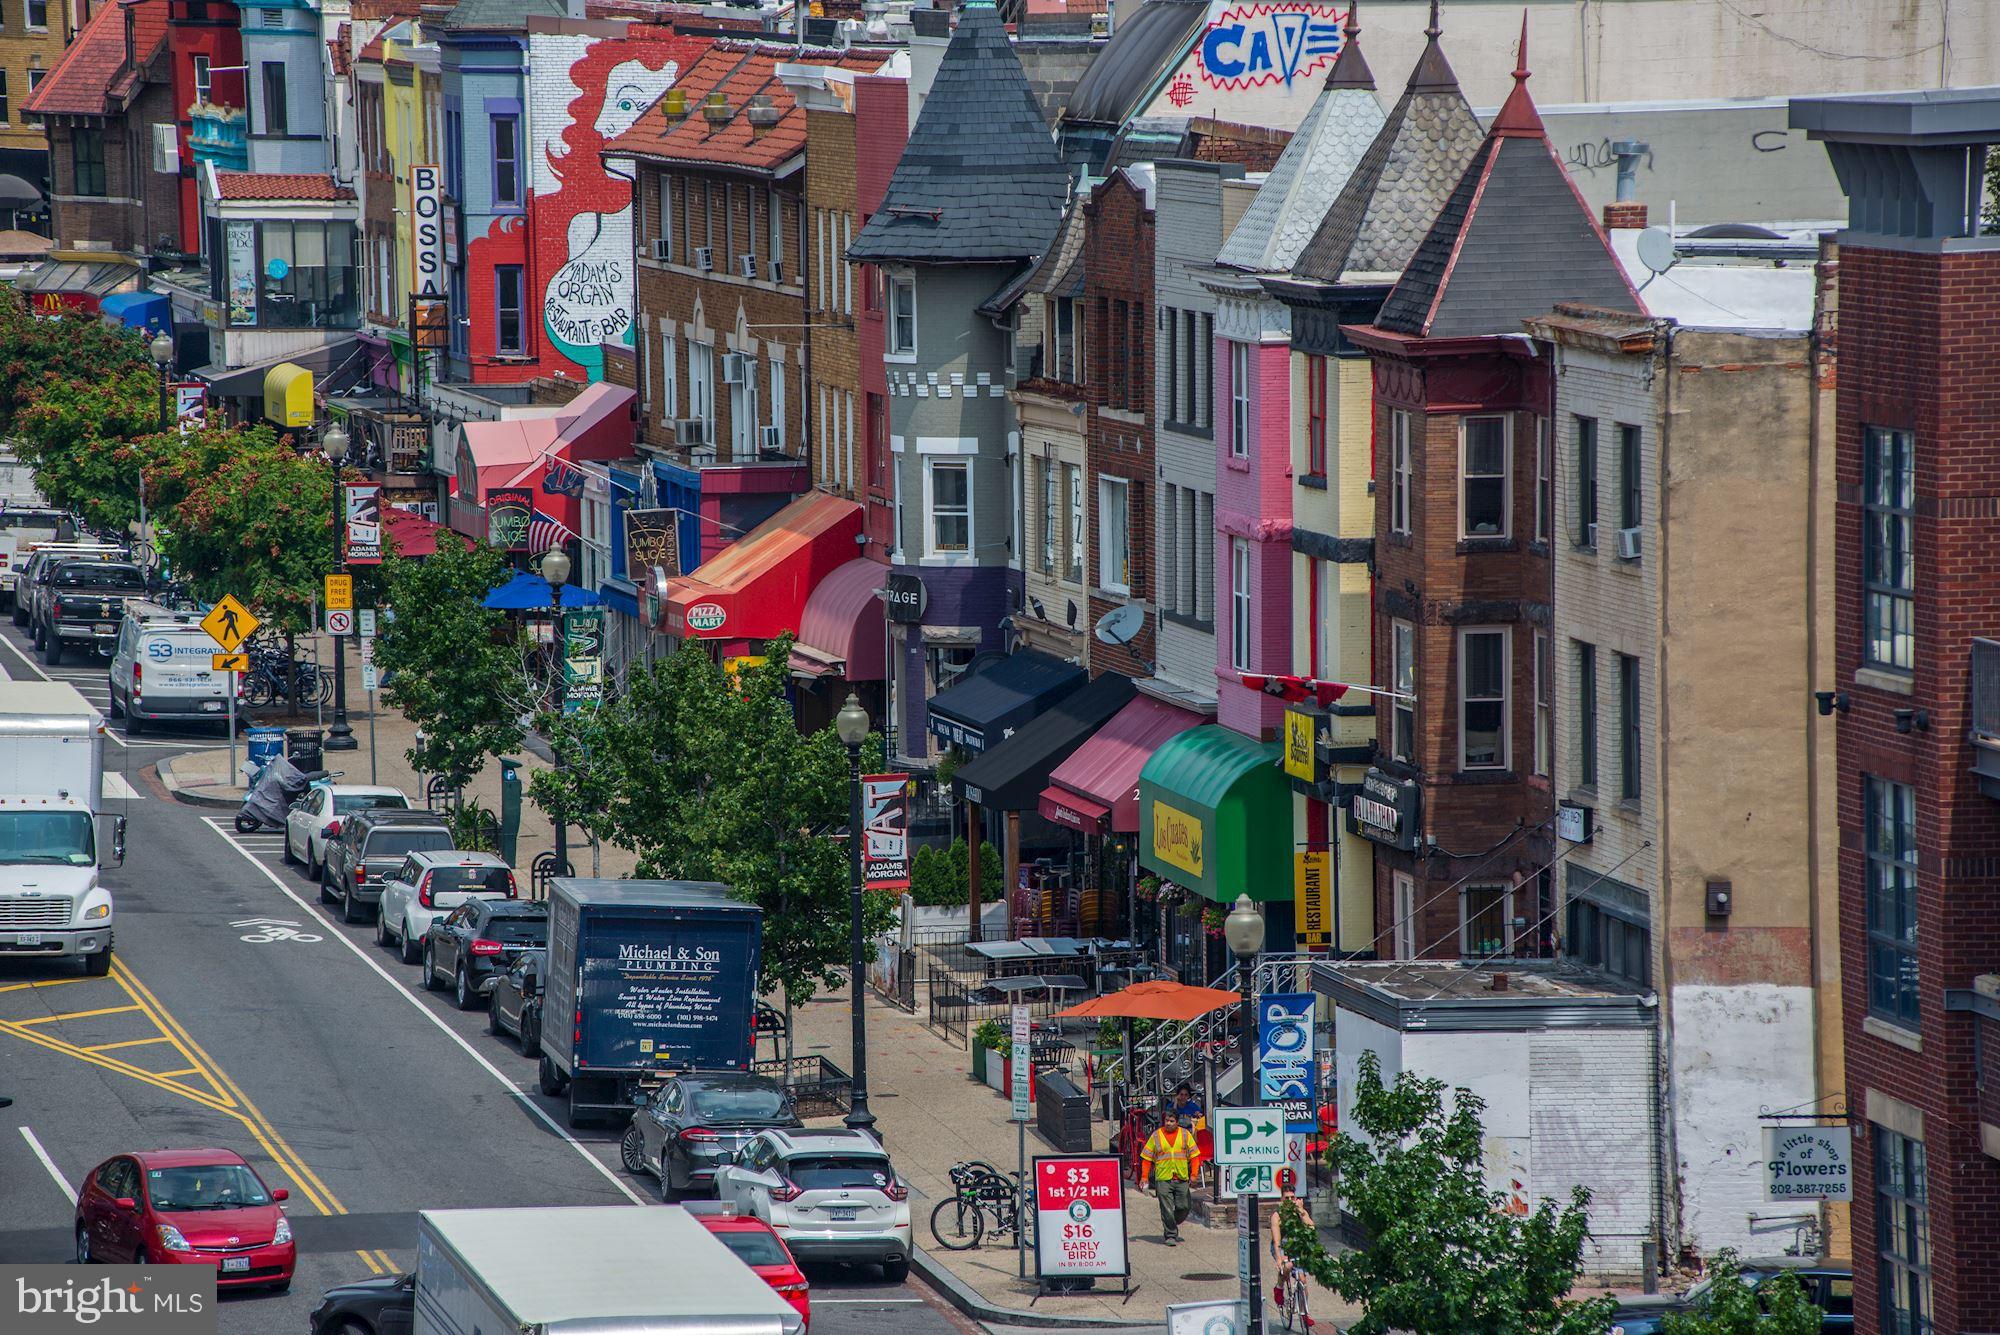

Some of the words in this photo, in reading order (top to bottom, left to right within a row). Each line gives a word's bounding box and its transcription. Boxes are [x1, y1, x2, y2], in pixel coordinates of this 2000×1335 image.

[416, 168, 438, 295] BOSSA
[560, 260, 622, 283] MADAM'S
[558, 281, 615, 306] ORGAN
[545, 297, 592, 344] RESTAURANT
[600, 307, 630, 336] BAR
[488, 492, 531, 507] ORIGINAL
[350, 489, 380, 544] EAT
[490, 515, 531, 528] JUMBO
[493, 530, 528, 542] SLICE
[629, 536, 665, 549] JUMBO
[634, 548, 667, 561] SLICE
[329, 578, 347, 586] DRUG
[330, 588, 347, 596] FREE
[692, 606, 723, 618] PIZZA
[692, 617, 722, 627] MART
[174, 646, 228, 656] INTEGRATIO
[866, 785, 906, 859] EAT
[869, 862, 903, 871] ADAMS
[866, 870, 907, 879] MORGAN
[1305, 867, 1321, 931] RESTAURANT
[1306, 932, 1322, 944] BAR
[619, 944, 672, 960] Michael
[677, 946, 690, 960] &
[695, 946, 720, 960] Son
[626, 960, 712, 971] PLUMBING
[629, 985, 650, 994] Water
[674, 986, 710, 996] Installation
[645, 993, 666, 1001] Water
[666, 994, 683, 1002] Line
[683, 995, 721, 1004] Replacement
[625, 1001, 637, 1009] All
[663, 1002, 693, 1012] Plumbing
[632, 1020, 703, 1029] www.michaelandson.com
[1263, 1003, 1309, 1098] SHOP
[1287, 1140, 1302, 1162] &
[1779, 1151, 1787, 1159] a
[1783, 1133, 1815, 1151] little
[1817, 1138, 1840, 1161] shop
[1800, 1148, 1814, 1159] of
[1067, 1167, 1090, 1185] $3
[1768, 1161, 1848, 1179] Flowers
[1048, 1187, 1066, 1198] 1st
[1068, 1185, 1088, 1199] 1/2
[1091, 1186, 1110, 1197] HR
[1063, 1223, 1093, 1240] $16
[1063, 1241, 1100, 1251] EARLY
[1068, 1251, 1097, 1260] BIRD
